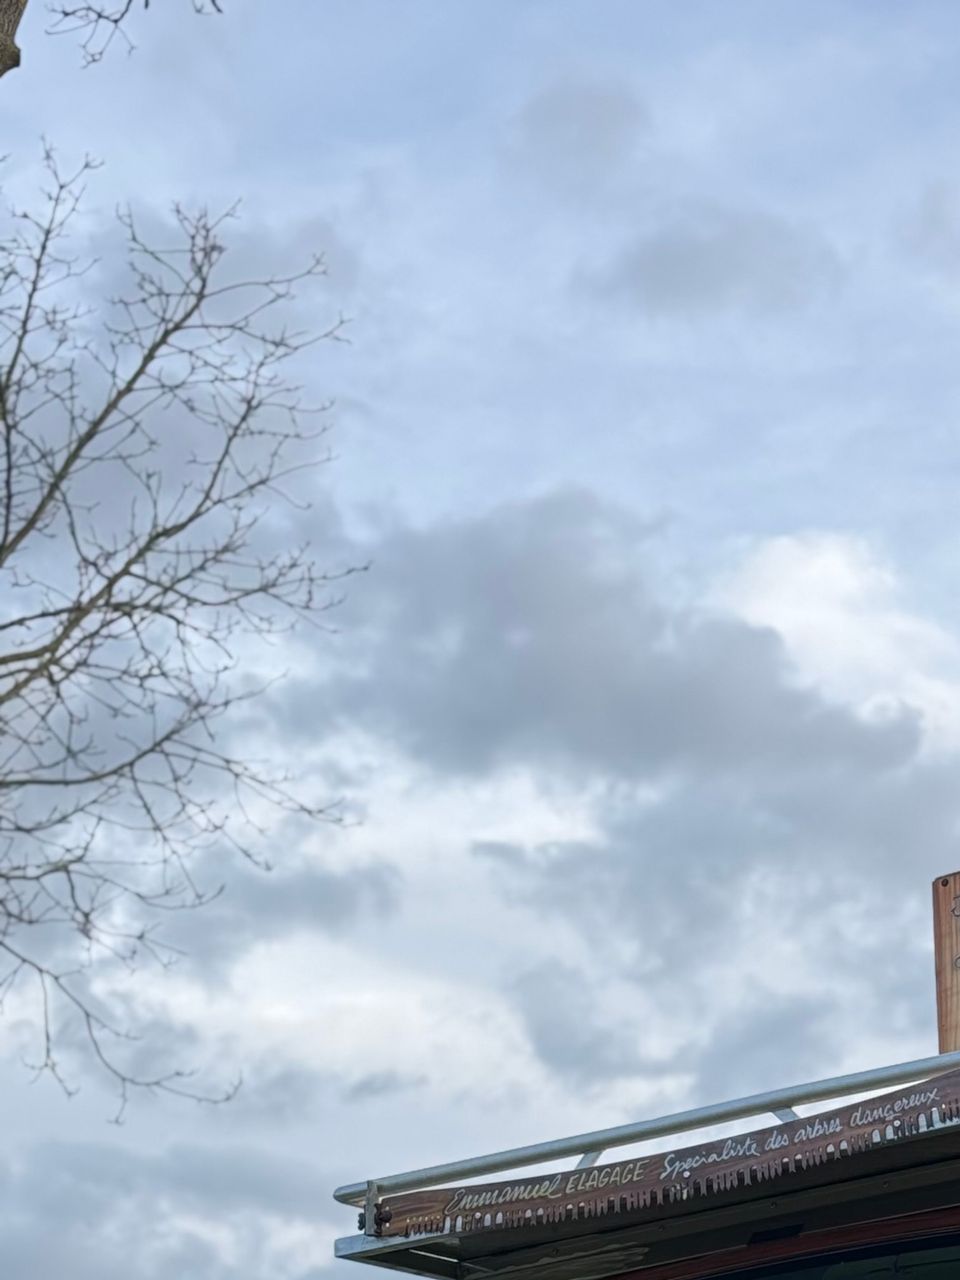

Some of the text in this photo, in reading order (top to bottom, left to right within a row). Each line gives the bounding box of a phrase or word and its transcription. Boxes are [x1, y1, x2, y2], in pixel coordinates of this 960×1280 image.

[444, 1174, 562, 1215] Emmanuel
[565, 1159, 650, 1195] ELAGAGE
[764, 1130, 790, 1151] des
[793, 1117, 843, 1144] arbres
[850, 1088, 941, 1128] dangereux
